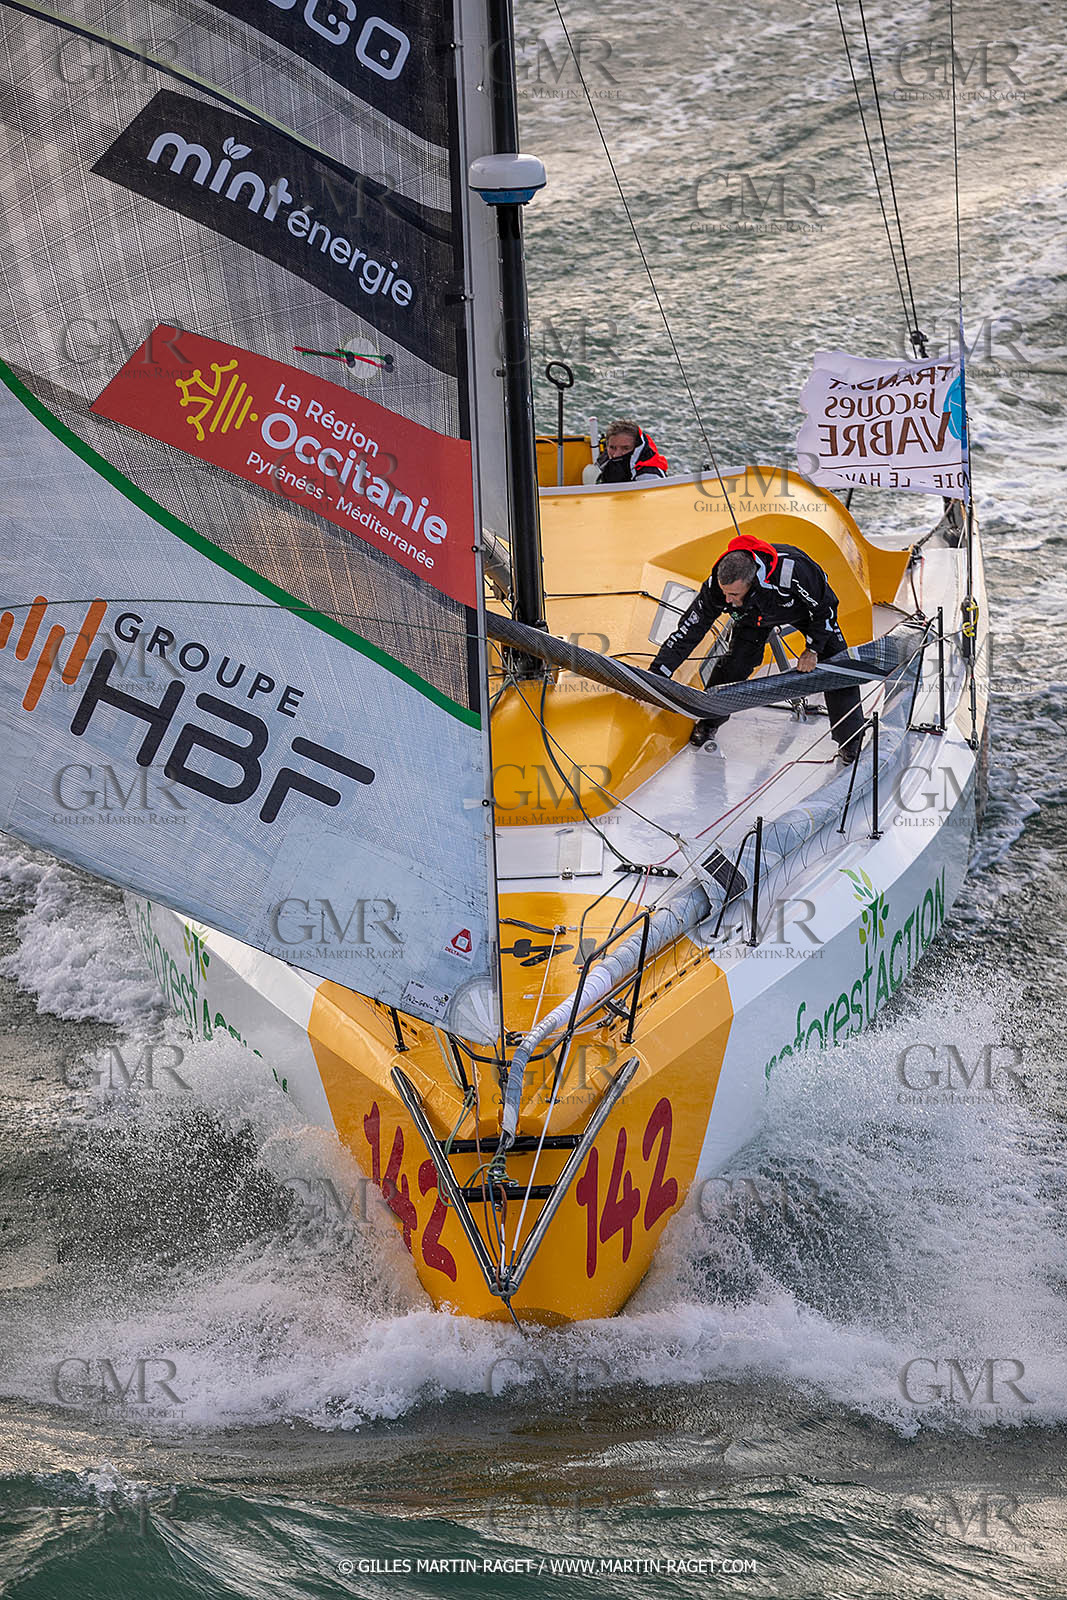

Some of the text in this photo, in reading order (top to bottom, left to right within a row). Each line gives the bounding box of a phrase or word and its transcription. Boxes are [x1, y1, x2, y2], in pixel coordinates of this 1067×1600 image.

[268, 0, 411, 80] GO
[261, 412, 448, 544] Occitanie
[274, 383, 379, 458] La Région
[246, 451, 324, 501] Pyrénées
[336, 497, 435, 569] Méditerranée
[114, 612, 304, 719] GROUPE
[70, 648, 376, 824] HBF
[364, 1101, 458, 1283] 142
[575, 1097, 678, 1279] 142
